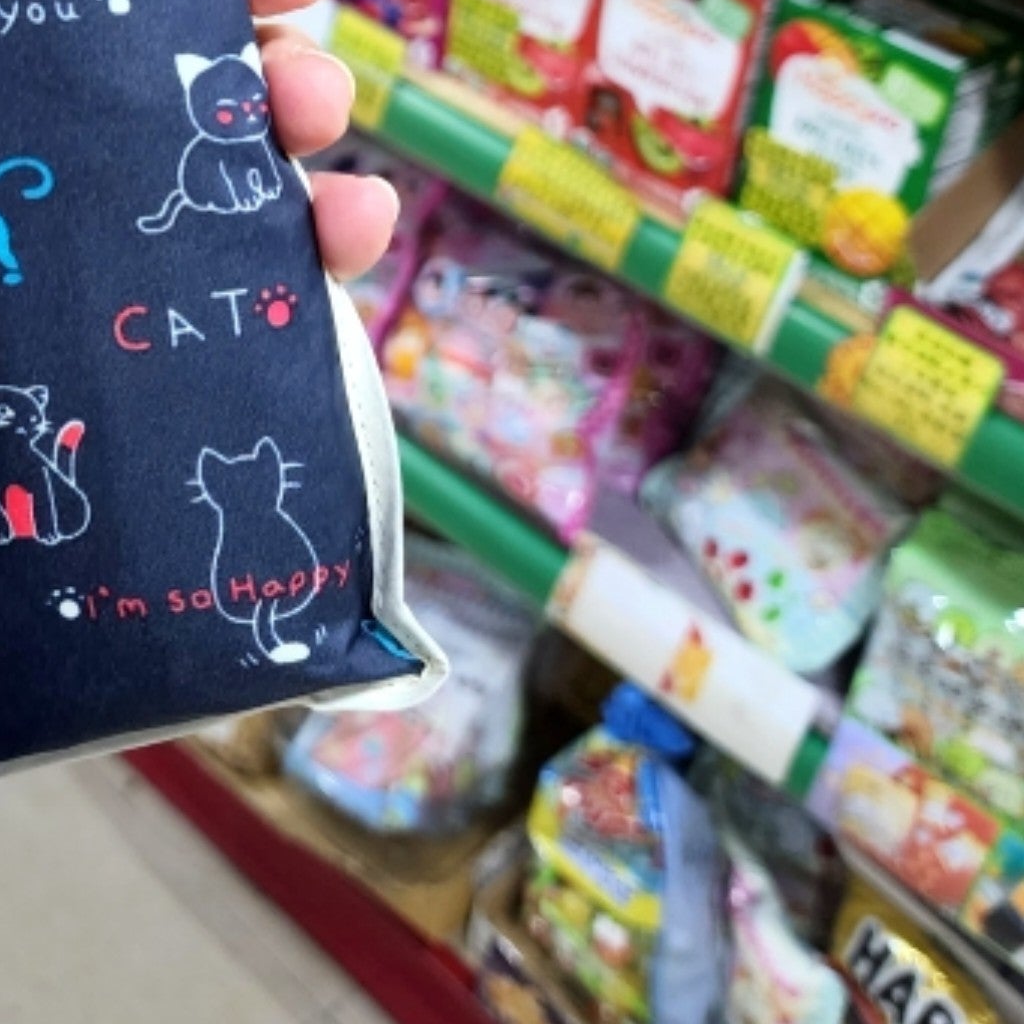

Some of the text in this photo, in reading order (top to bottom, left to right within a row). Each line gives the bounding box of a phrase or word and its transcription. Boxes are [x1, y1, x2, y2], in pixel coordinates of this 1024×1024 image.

[113, 288, 249, 352] CAT
[167, 584, 213, 613] so
[229, 558, 351, 603] Happy
